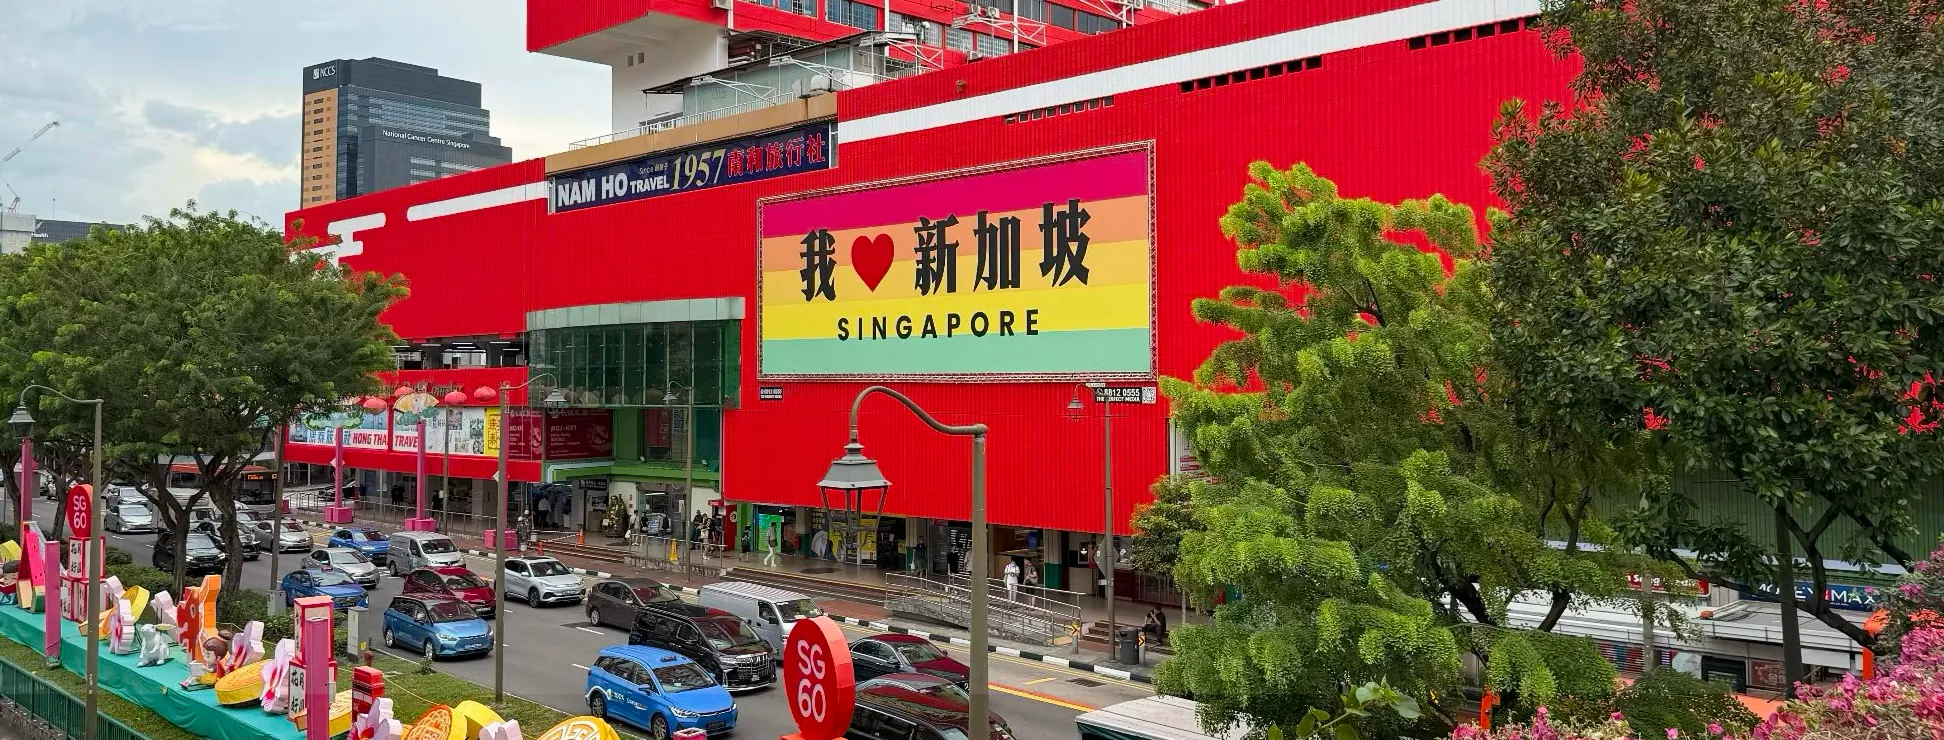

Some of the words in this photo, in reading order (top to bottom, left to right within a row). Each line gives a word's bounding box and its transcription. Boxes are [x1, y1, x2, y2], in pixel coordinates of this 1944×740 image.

[320, 65, 335, 78] NCCS
[383, 129, 406, 140] National
[407, 133, 427, 143] Cancer
[428, 136, 445, 145] Centre
[446, 139, 470, 150] Singapore
[727, 132, 826, 178] 南和旅行社
[557, 178, 596, 207] NAM
[601, 172, 628, 200] HO
[630, 174, 670, 194] TRAVEL
[671, 148, 726, 191] 1957
[800, 228, 837, 301] 我
[913, 198, 1092, 296] 新加坡
[837, 308, 1039, 341] SINGAPORE
[1122, 388, 1140, 397] 0555
[352, 432, 373, 445] HONG
[374, 433, 388, 446] THA
[395, 434, 418, 448] TRAVE
[73, 495, 87, 511] SG
[73, 512, 87, 529] 60
[797, 639, 826, 680] SG
[797, 678, 827, 723] 60
